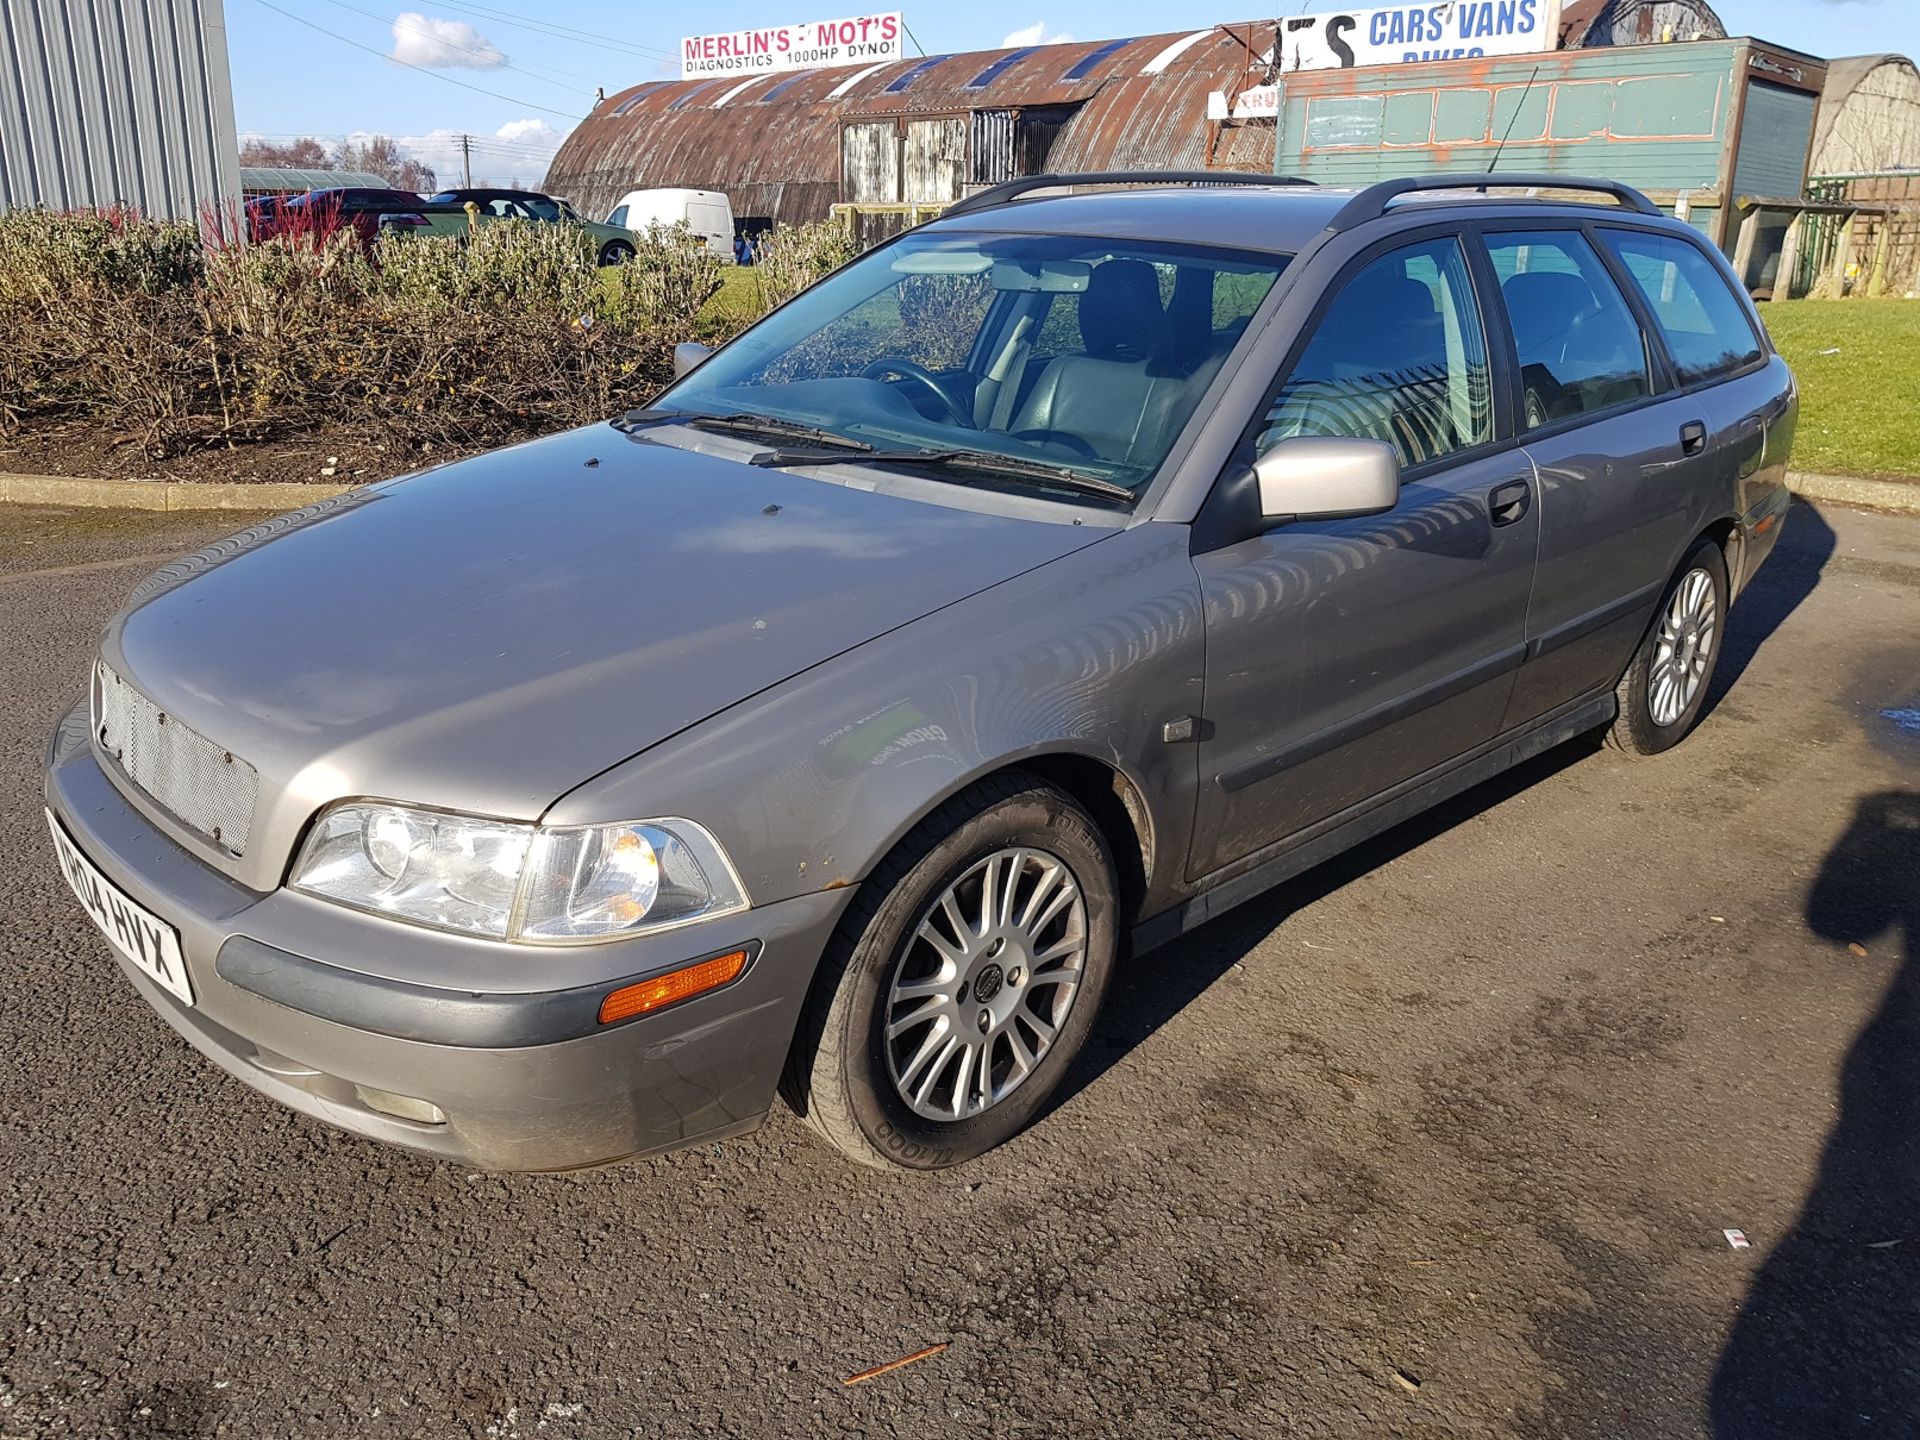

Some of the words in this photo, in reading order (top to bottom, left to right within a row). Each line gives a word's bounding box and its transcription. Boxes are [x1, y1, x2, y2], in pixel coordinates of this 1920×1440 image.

[685, 29, 790, 60] MERLIN'S
[818, 16, 897, 47] MOT'S
[1369, 7, 1442, 47] CARS
[1459, 0, 1536, 39] VANS
[686, 54, 773, 73] DIAGNOSTICS
[787, 47, 839, 63] 1000HP
[848, 41, 895, 57] DYNO!
[106, 888, 174, 984] HVX
